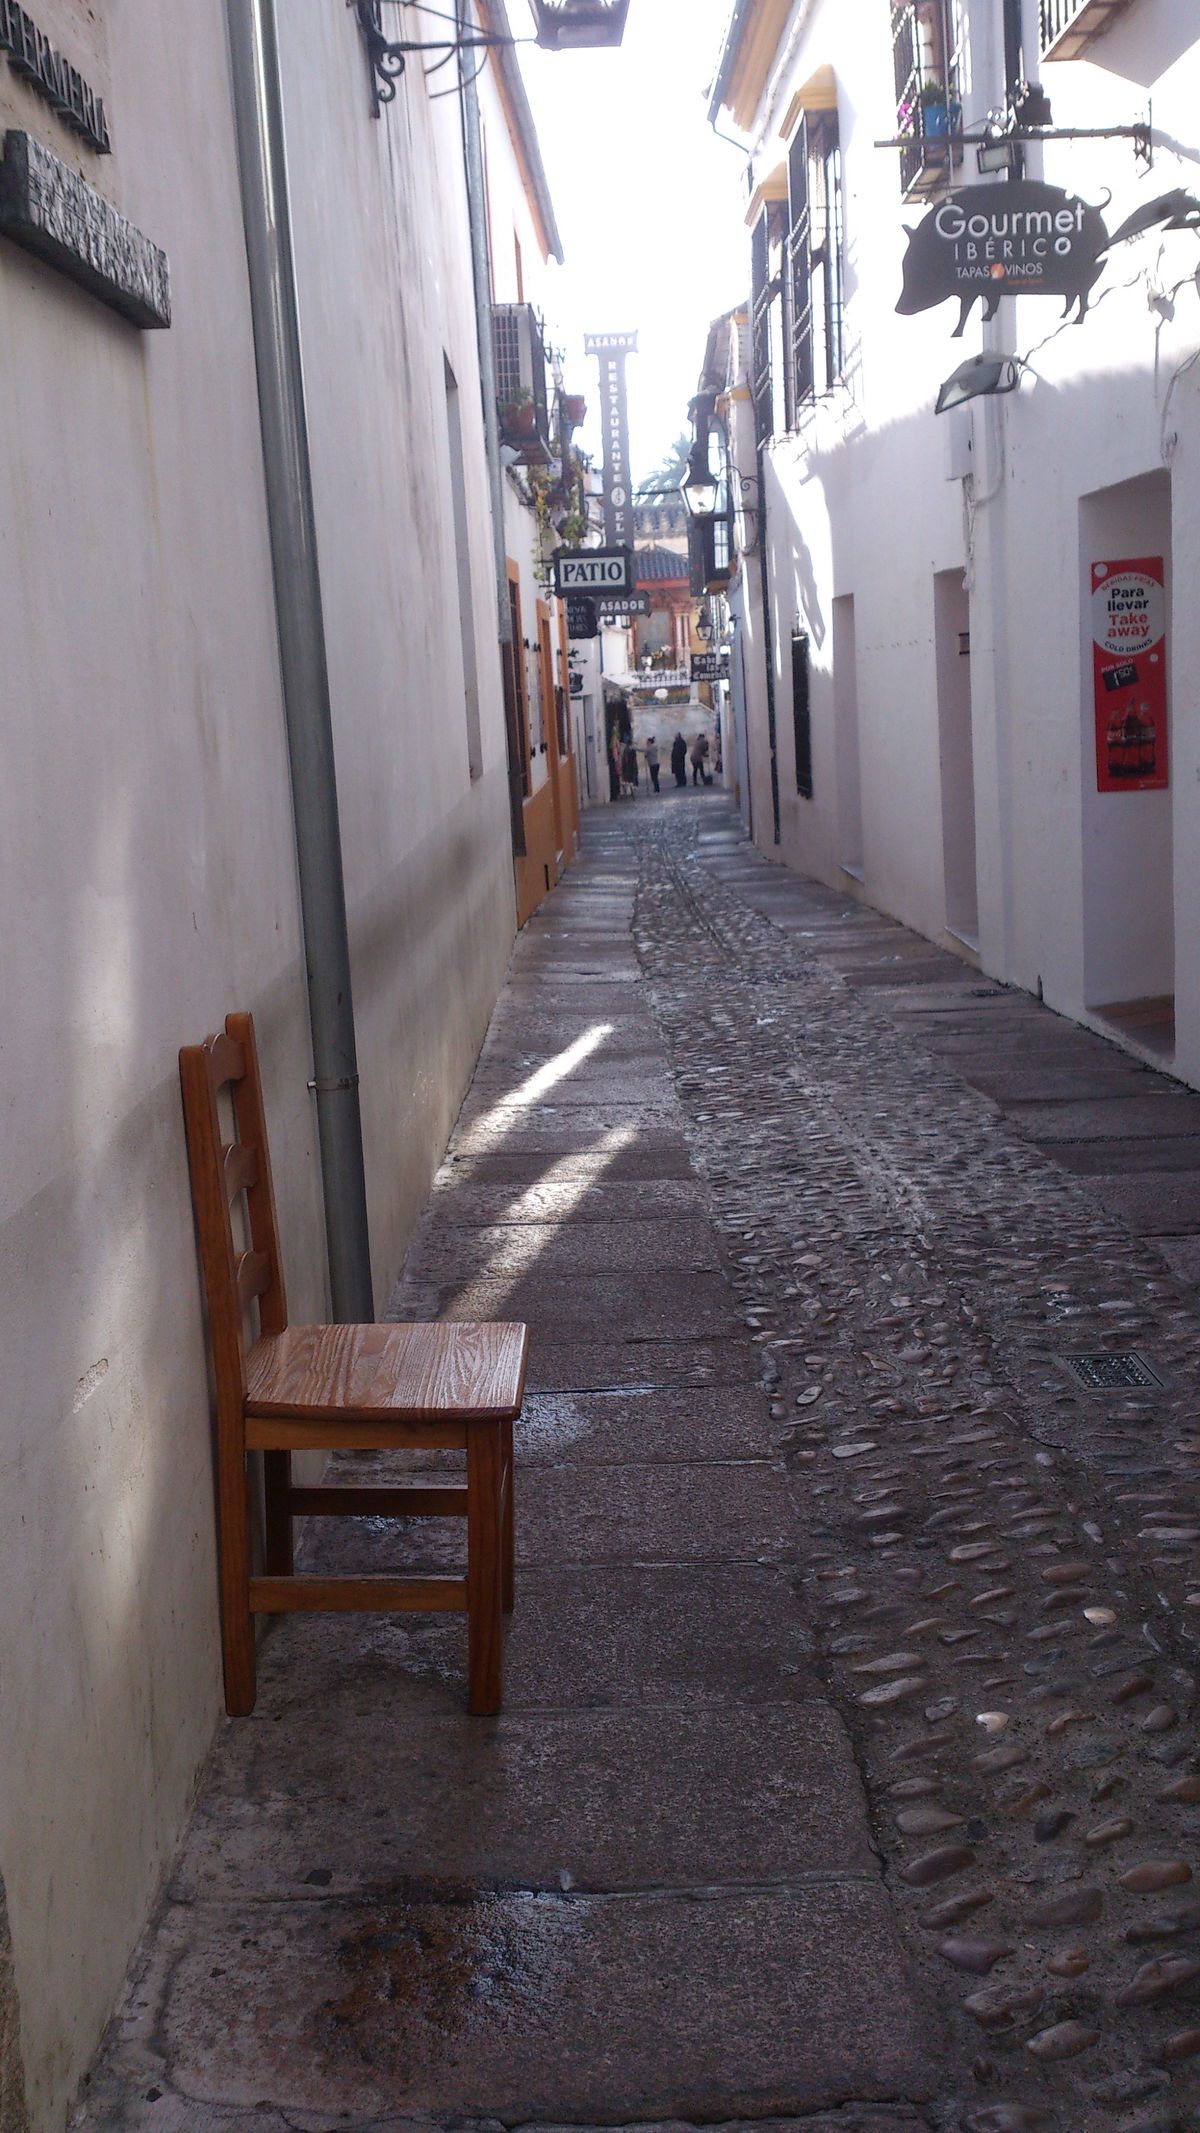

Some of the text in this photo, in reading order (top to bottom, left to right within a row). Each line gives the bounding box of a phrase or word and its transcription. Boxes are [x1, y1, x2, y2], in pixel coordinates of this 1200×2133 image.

[935, 202, 1085, 239] Gourmet
[954, 236, 1072, 260] IBÉRICO
[955, 262, 1043, 279] TAPAS VINOS
[607, 361, 622, 482] RESTAURANTE
[563, 561, 622, 582] PATIO
[1111, 588, 1144, 599] Para
[599, 600, 645, 612] ASADOR
[1107, 599, 1149, 612] llevar
[1109, 612, 1148, 626] Take
[1107, 624, 1150, 638] away
[1104, 638, 1153, 652] COLD DRINKS
